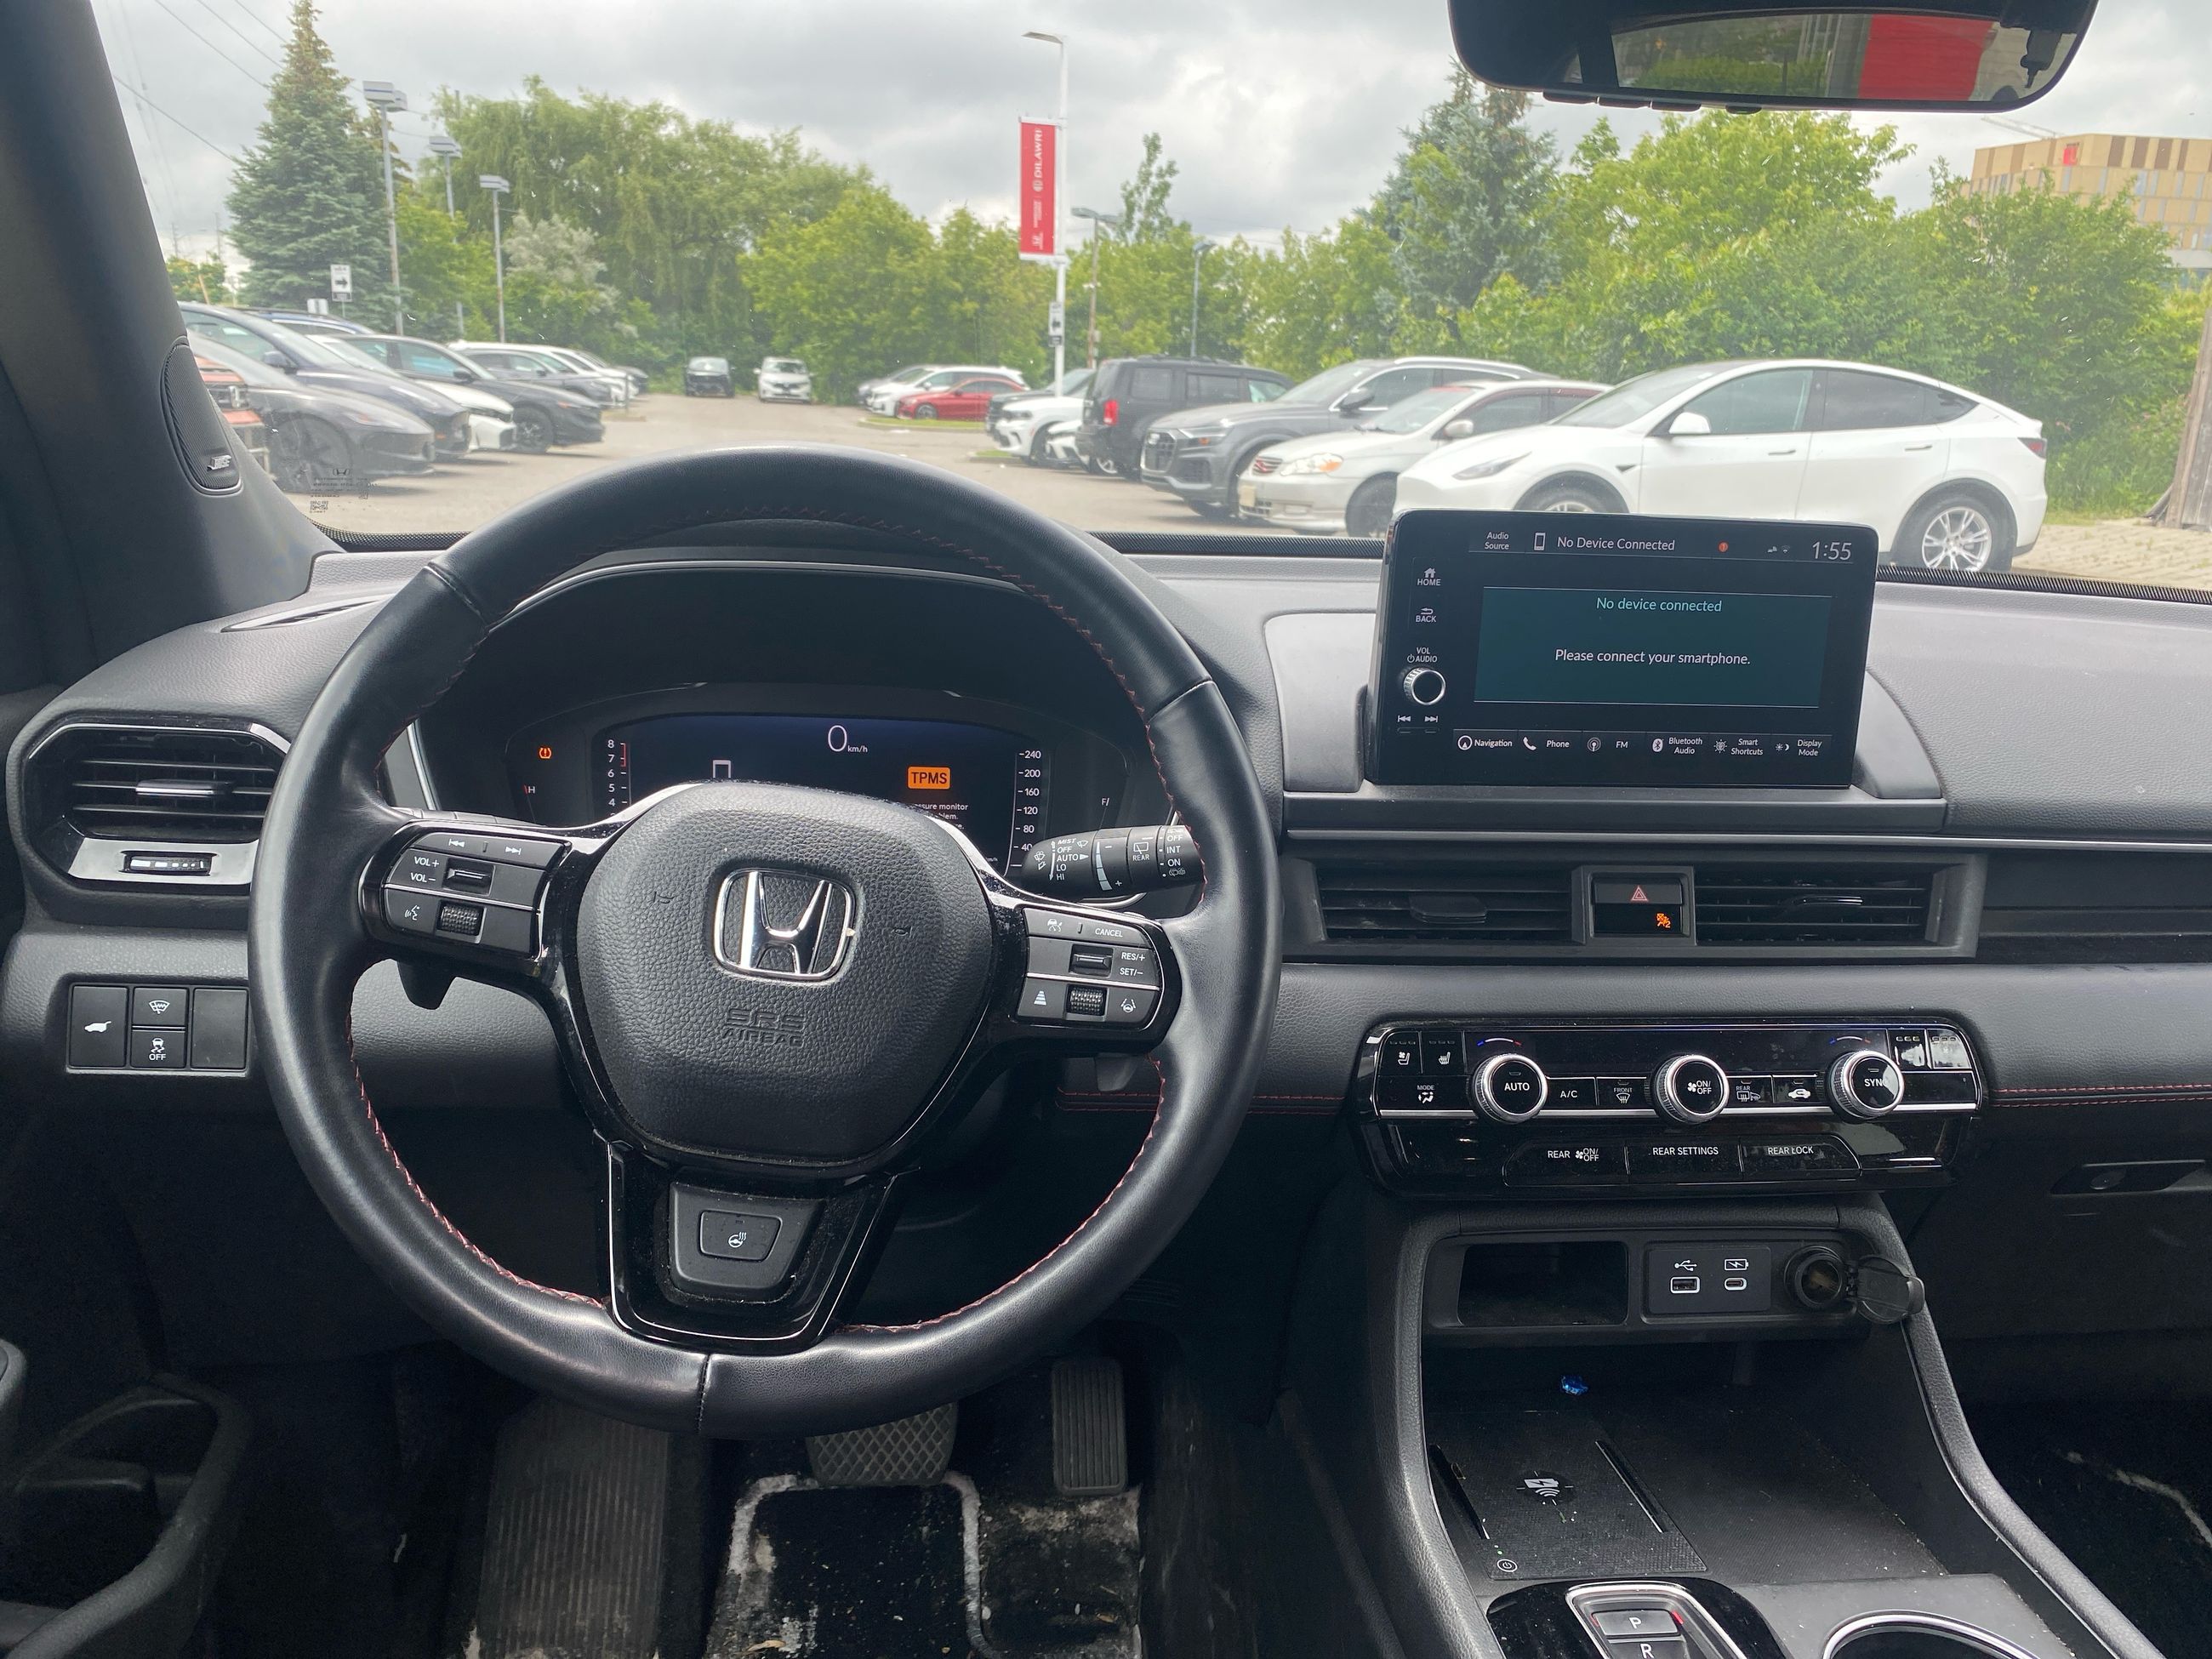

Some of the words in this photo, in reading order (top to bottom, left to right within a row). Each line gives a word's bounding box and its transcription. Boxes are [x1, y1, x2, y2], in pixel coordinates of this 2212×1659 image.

[1486, 532, 1509, 540] Audio
[1557, 537, 1574, 548] No
[1576, 537, 1614, 549] Device
[1616, 539, 1675, 551] Connected
[1812, 541, 1852, 561] 1:55
[1596, 598, 1615, 609] No
[1617, 598, 1656, 611] device
[1660, 600, 1722, 612] connected
[1555, 650, 1594, 662] Please
[1597, 651, 1645, 663] connect
[1648, 653, 1676, 665] your
[1678, 653, 1751, 665] smartphone.
[607, 739, 614, 749] 8
[1474, 739, 1513, 748] Navigation
[1546, 739, 1570, 748] Phone
[1616, 740, 1628, 749] FM
[1668, 737, 1703, 745] Bluetooth
[1797, 739, 1822, 749] Display
[847, 744, 869, 753] km/h
[1674, 746, 1696, 755] Audio
[1730, 747, 1764, 755] Shortcuts
[607, 754, 615, 763] 7
[1024, 750, 1041, 759] 240
[607, 768, 614, 778] 6
[1024, 769, 1040, 778] 200
[911, 772, 947, 784] TPMS
[608, 783, 615, 792] 5
[1024, 788, 1040, 796] 160
[608, 798, 616, 807] 4
[1023, 807, 1038, 815] 120
[1166, 845, 1181, 853] INT
[1057, 853, 1079, 862] AUTO
[1132, 853, 1150, 862] REAR
[1167, 858, 1181, 867] ON
[1095, 927, 1123, 937] CANCEL
[1504, 1082, 1530, 1092] AUTO
[1696, 1080, 1711, 1088] ON/
[1560, 1090, 1577, 1098] A/C
[1548, 1150, 1570, 1159] REAR
[1652, 1147, 1675, 1155] REAR
[1677, 1147, 1719, 1156] SETTINGS
[1767, 1146, 1788, 1155] REAR
[1791, 1146, 1814, 1155] LOCK
[1628, 1616, 1642, 1629] P
[1639, 1643, 1655, 1659] R
